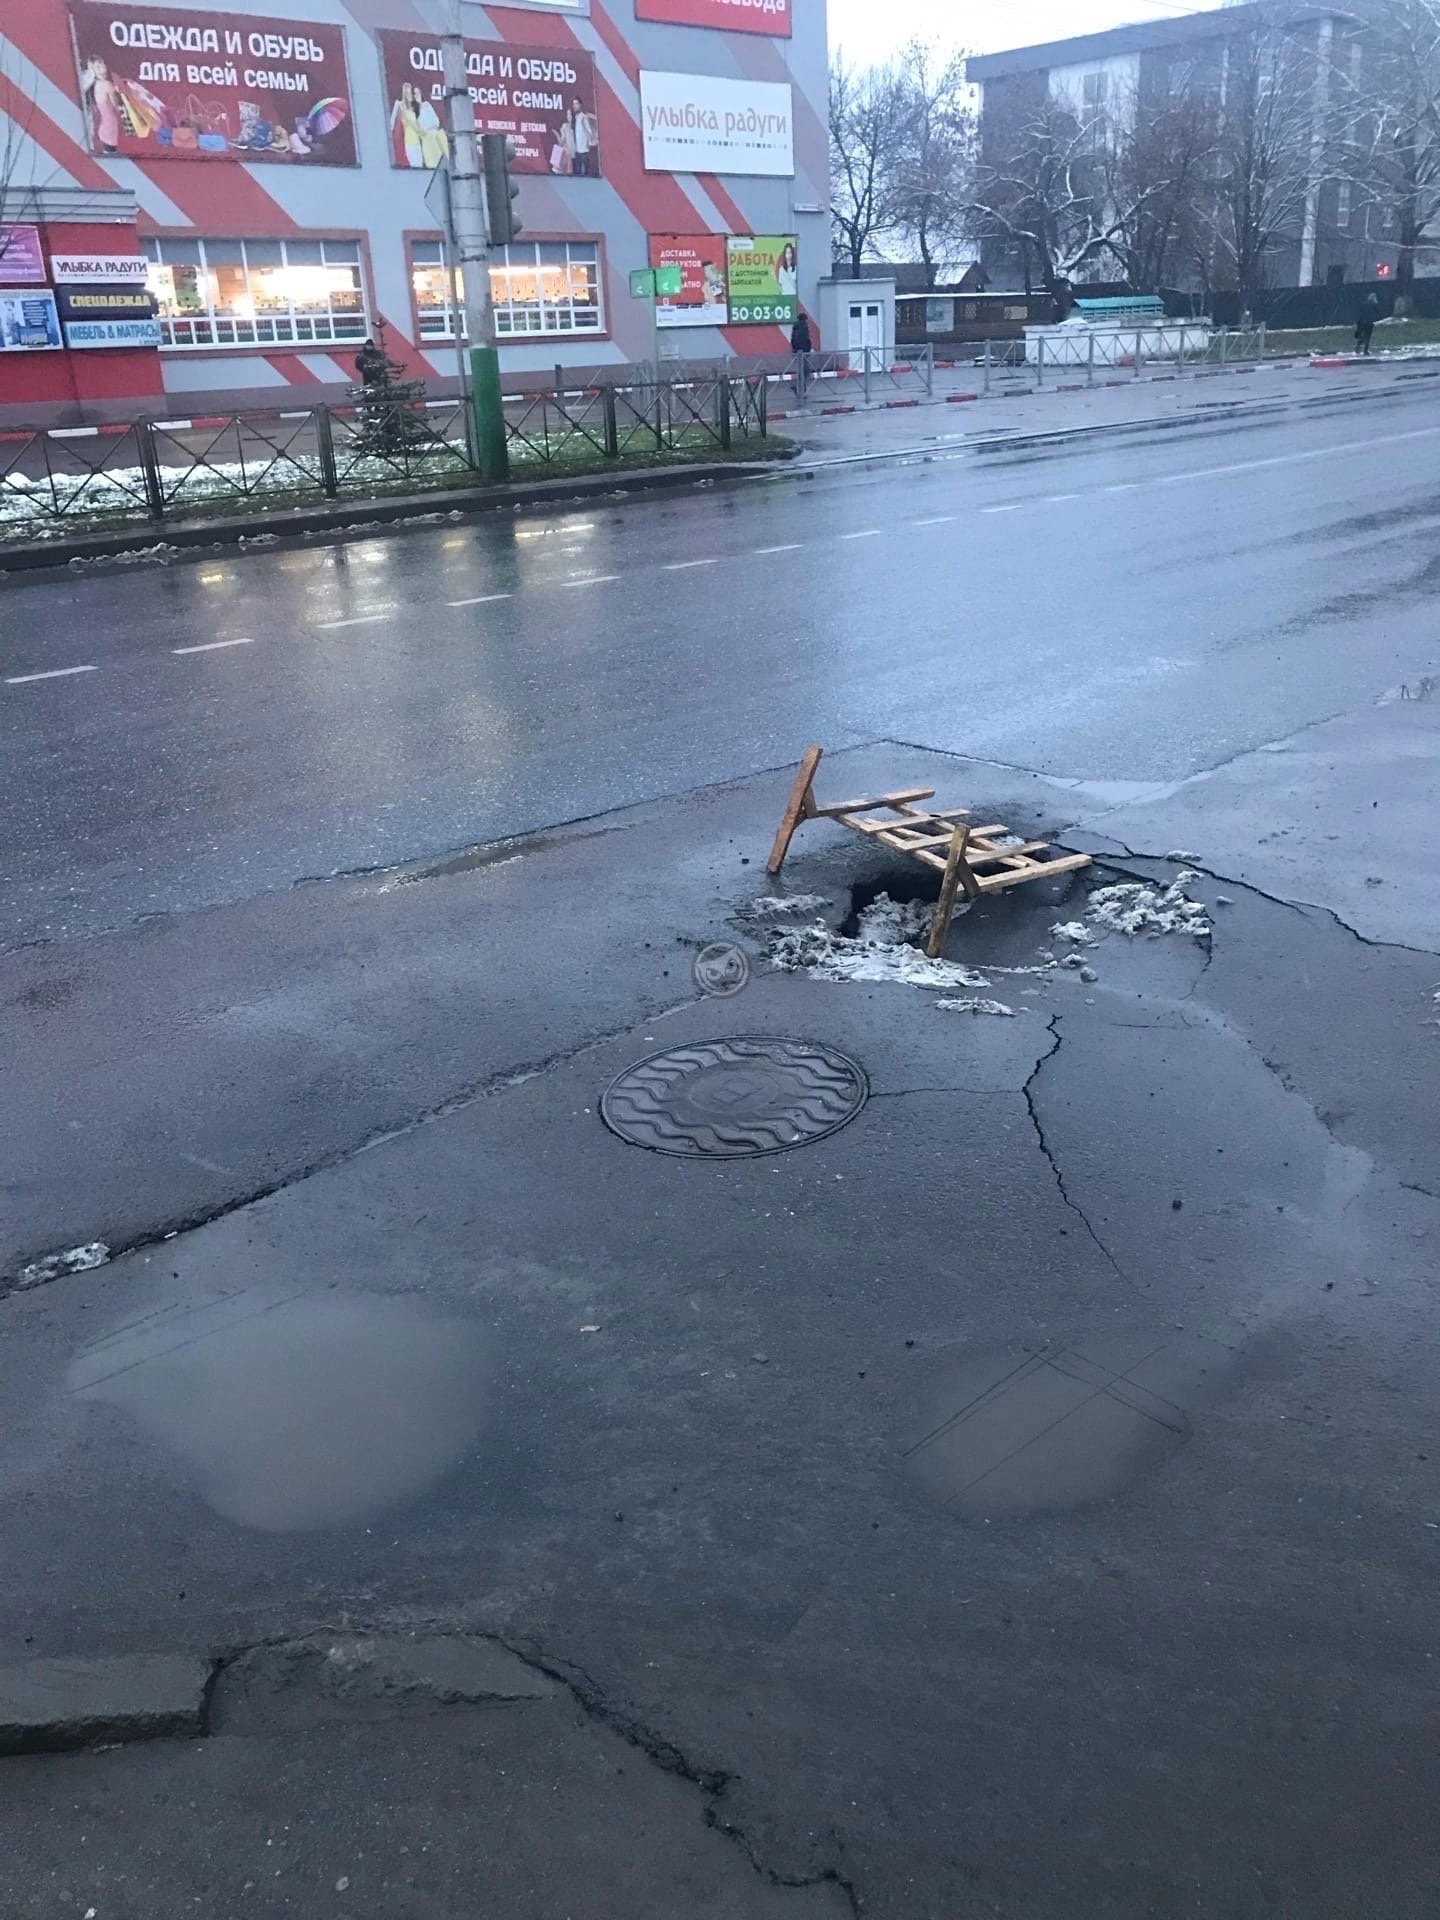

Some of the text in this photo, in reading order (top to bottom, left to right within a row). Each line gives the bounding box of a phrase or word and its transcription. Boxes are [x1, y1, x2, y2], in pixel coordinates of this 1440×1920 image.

[110, 21, 324, 63] ОДЕЖДА И ОБУВЬ
[139, 60, 309, 92] для всей семьи
[409, 47, 577, 84] ОДДА И ОБУВЬ
[513, 90, 563, 110] семьи
[647, 103, 786, 138] улыбка радуги
[57, 262, 147, 273] УЛЫБКА РАДУГИ
[729, 252, 775, 266] РАБОТА
[70, 322, 160, 340] МЕБЕЛЬ & МАТРАСЫ
